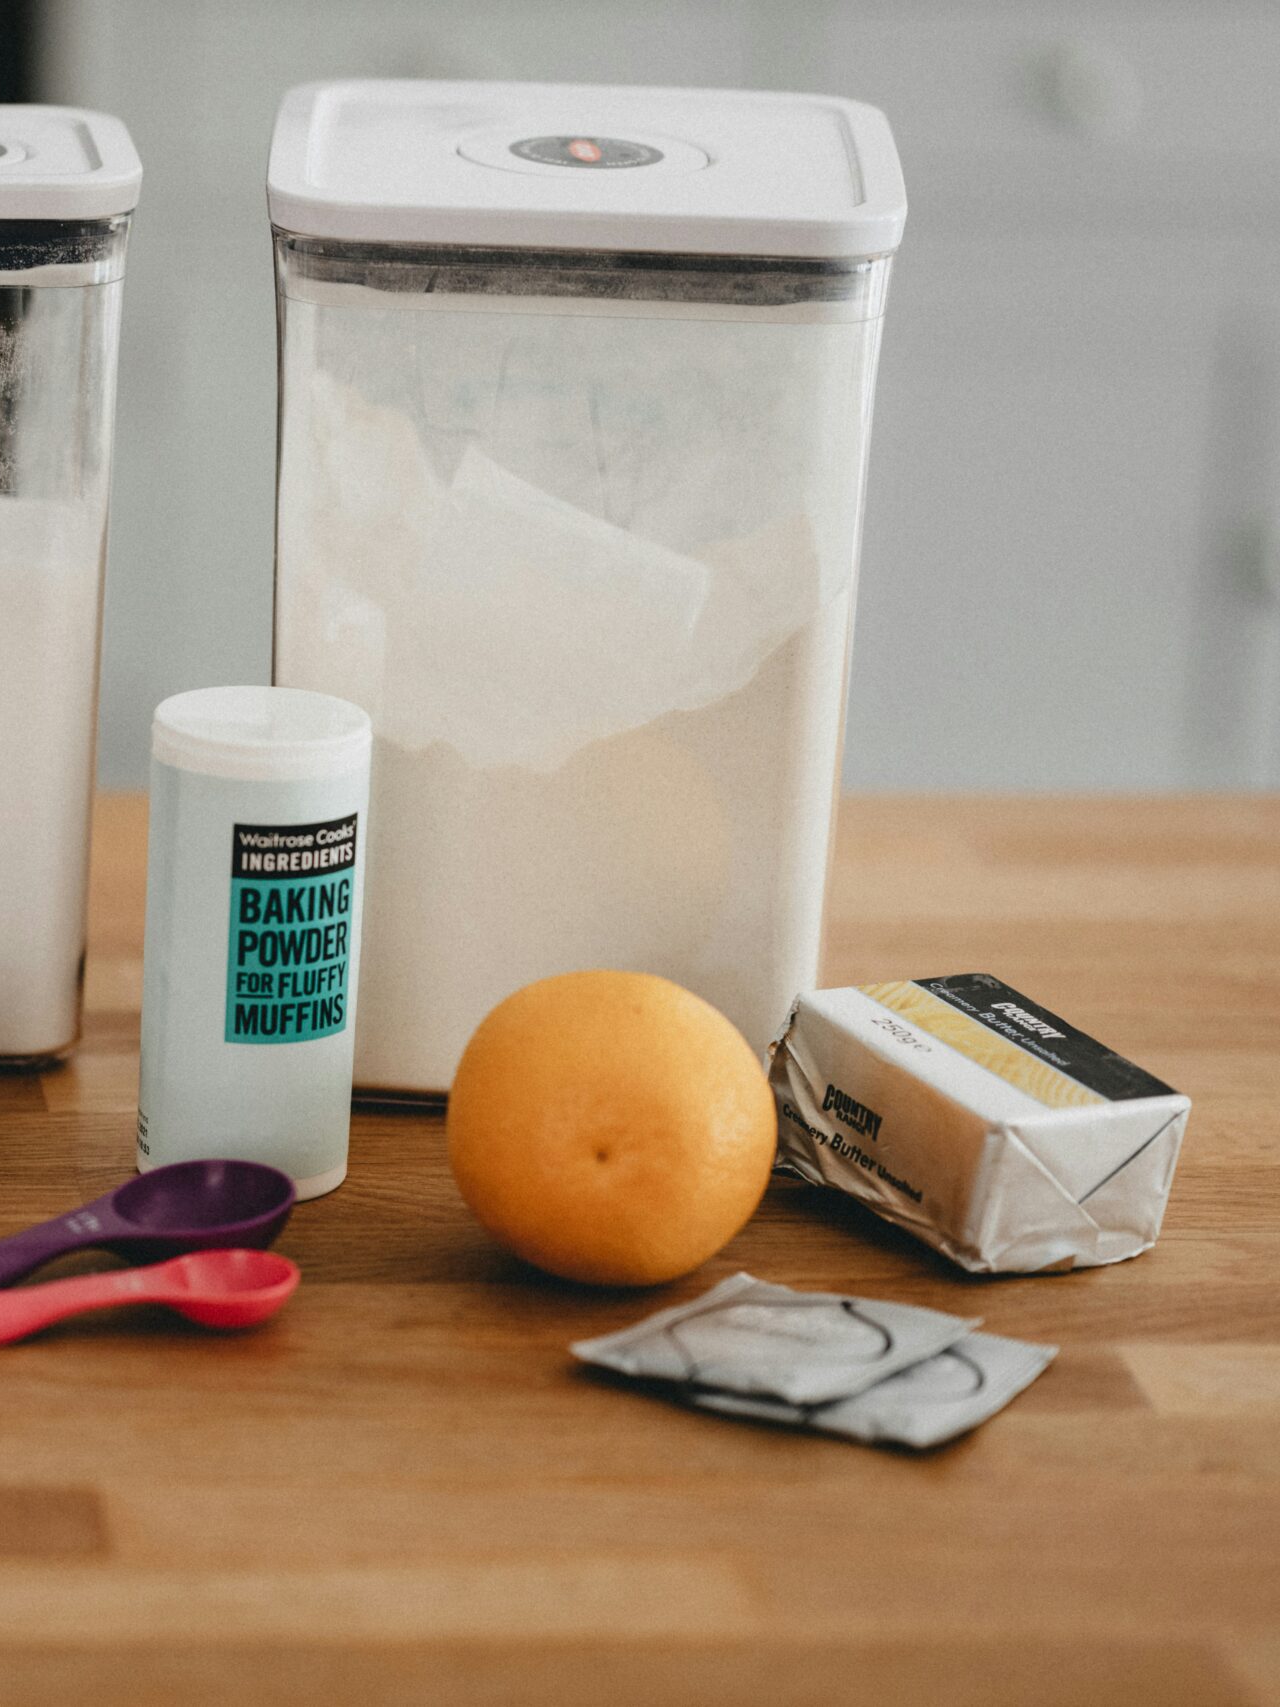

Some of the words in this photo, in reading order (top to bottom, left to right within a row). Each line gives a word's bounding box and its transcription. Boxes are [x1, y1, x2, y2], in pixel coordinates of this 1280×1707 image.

[239, 831, 314, 849] Waitrose
[241, 842, 354, 872] INGREDIENTS
[239, 878, 350, 924] BAKING
[237, 921, 348, 967] POWDER
[235, 971, 274, 994] FOR
[277, 961, 347, 998] FLUFFY
[234, 994, 344, 1036] MUFFINS
[978, 1012, 1024, 1039] Butter
[990, 1002, 1066, 1039] COUNTRY
[822, 1084, 883, 1142] COUNTRY
[830, 1133, 878, 1171] Butter
